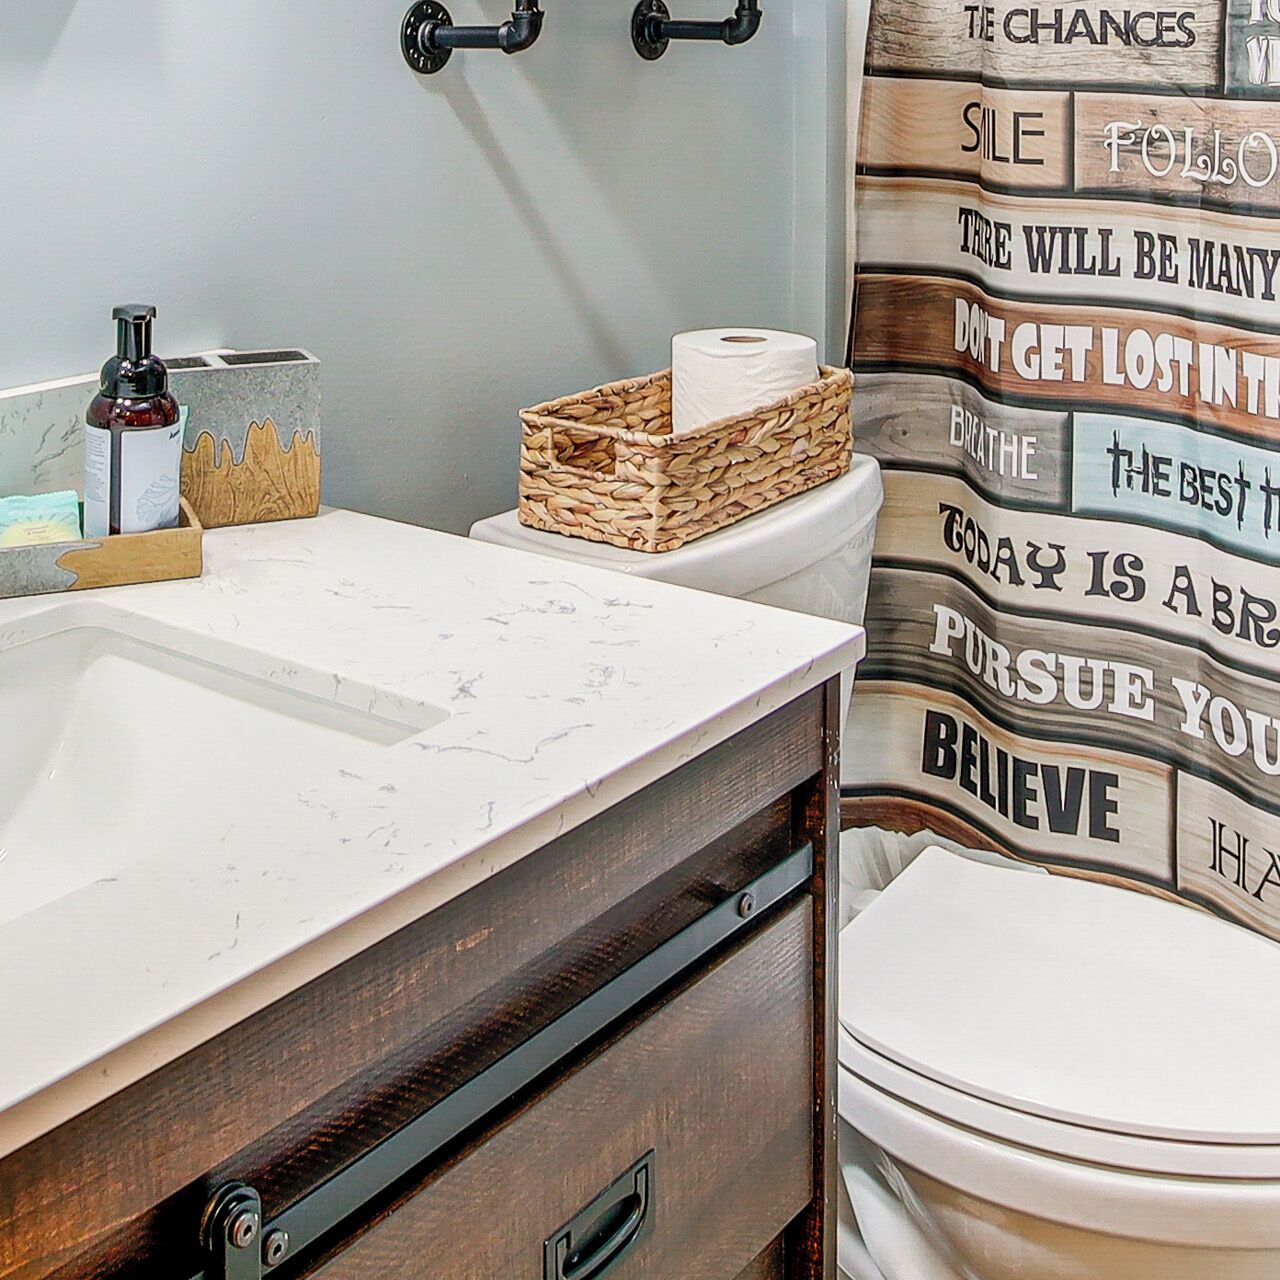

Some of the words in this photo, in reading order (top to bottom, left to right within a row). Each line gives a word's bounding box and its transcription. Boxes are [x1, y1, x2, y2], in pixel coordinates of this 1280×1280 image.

[1003, 7, 1197, 49] CHANCES
[1022, 223, 1121, 279] WILL
[1132, 229, 1180, 284] BE
[1010, 321, 1095, 384] GET
[1100, 325, 1196, 400] LOST
[1197, 341, 1239, 410] IN
[949, 404, 1039, 482] BREATHE
[938, 502, 1067, 592] TODAY
[1084, 549, 1147, 603] IS
[1161, 565, 1203, 618] A
[928, 603, 1156, 722] PURSUE
[921, 708, 1120, 844] BELIEVE
